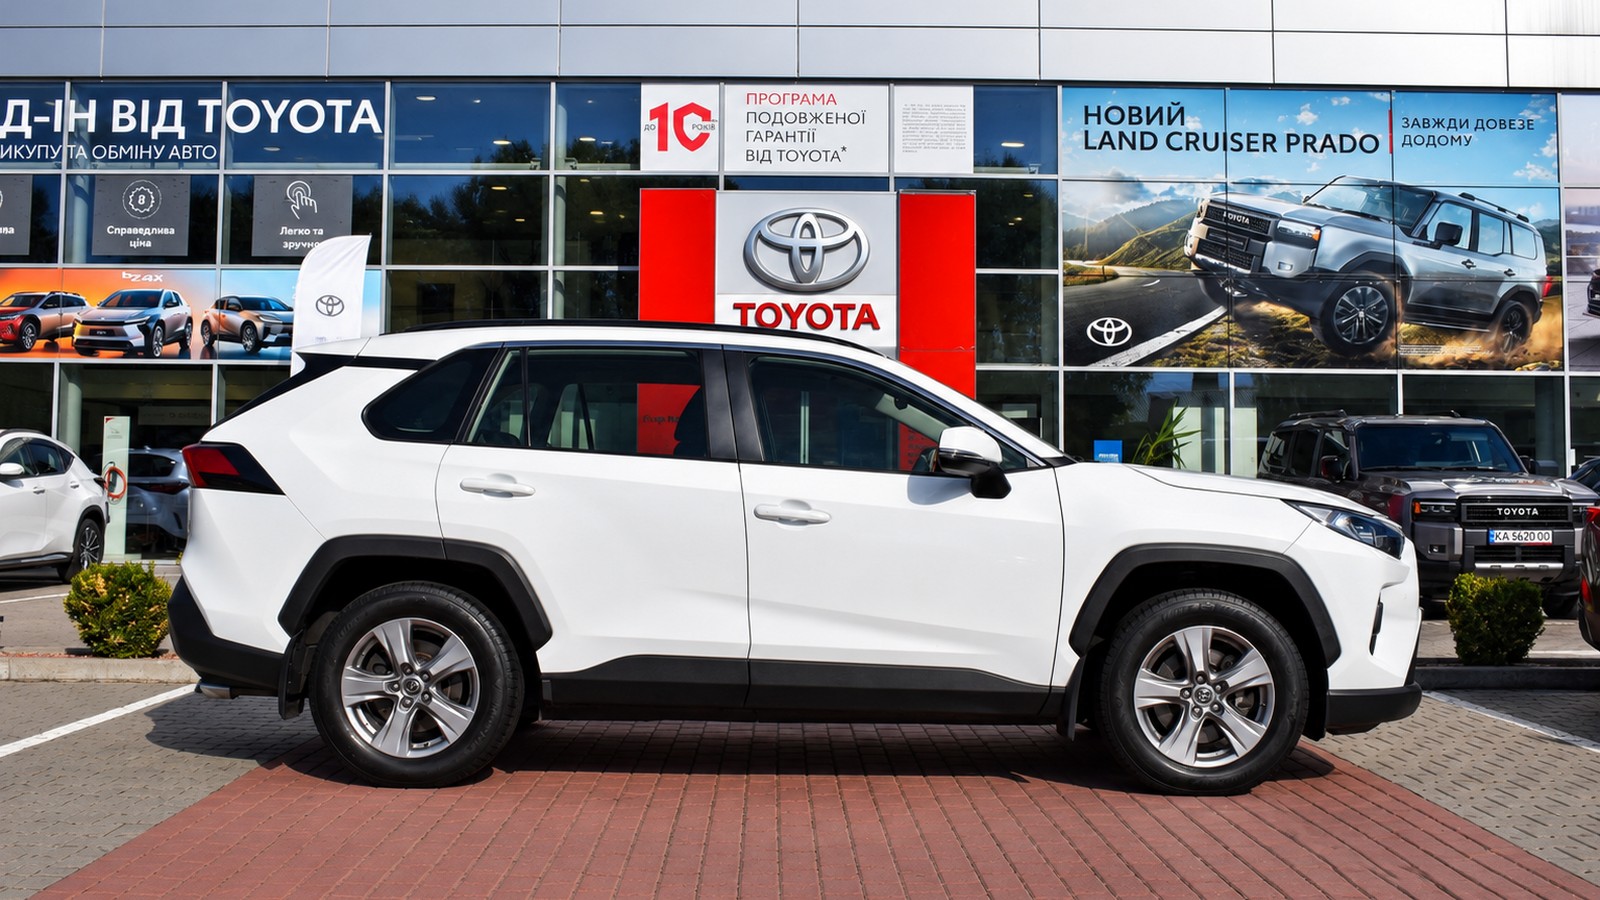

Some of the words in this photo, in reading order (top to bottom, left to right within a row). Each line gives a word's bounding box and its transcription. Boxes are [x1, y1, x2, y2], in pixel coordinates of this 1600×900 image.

[746, 93, 837, 105] ПРОГРАМА
[111, 99, 186, 140] ВІД
[198, 99, 383, 134] TOYOTA
[746, 110, 866, 125] ПОДОВЖЕНОЇ
[1084, 101, 1185, 126] НОВИЙ
[644, 124, 656, 132] ДО
[692, 123, 716, 131] РОКІВ
[1402, 117, 1469, 131] ЗАВЖДИ
[1474, 118, 1534, 131] ДОВЕЗЕ
[746, 128, 816, 143] ГАРАНТІЇ
[1084, 130, 1158, 151] LAND
[1165, 131, 1277, 153] CRUISER
[1286, 133, 1380, 154] PRADO
[1402, 135, 1472, 147] ДОДОМУ
[68, 145, 88, 160] ТА
[92, 145, 165, 160] ОБМІНУ
[168, 145, 217, 159] АВТО
[746, 149, 772, 164] ВІД
[106, 225, 175, 236] Справедлива
[280, 226, 311, 235] Легко
[129, 237, 152, 249] ціна
[733, 302, 880, 330] TOYOTA
[1497, 507, 1539, 515] TOYOTA
[1495, 531, 1510, 541] KA
